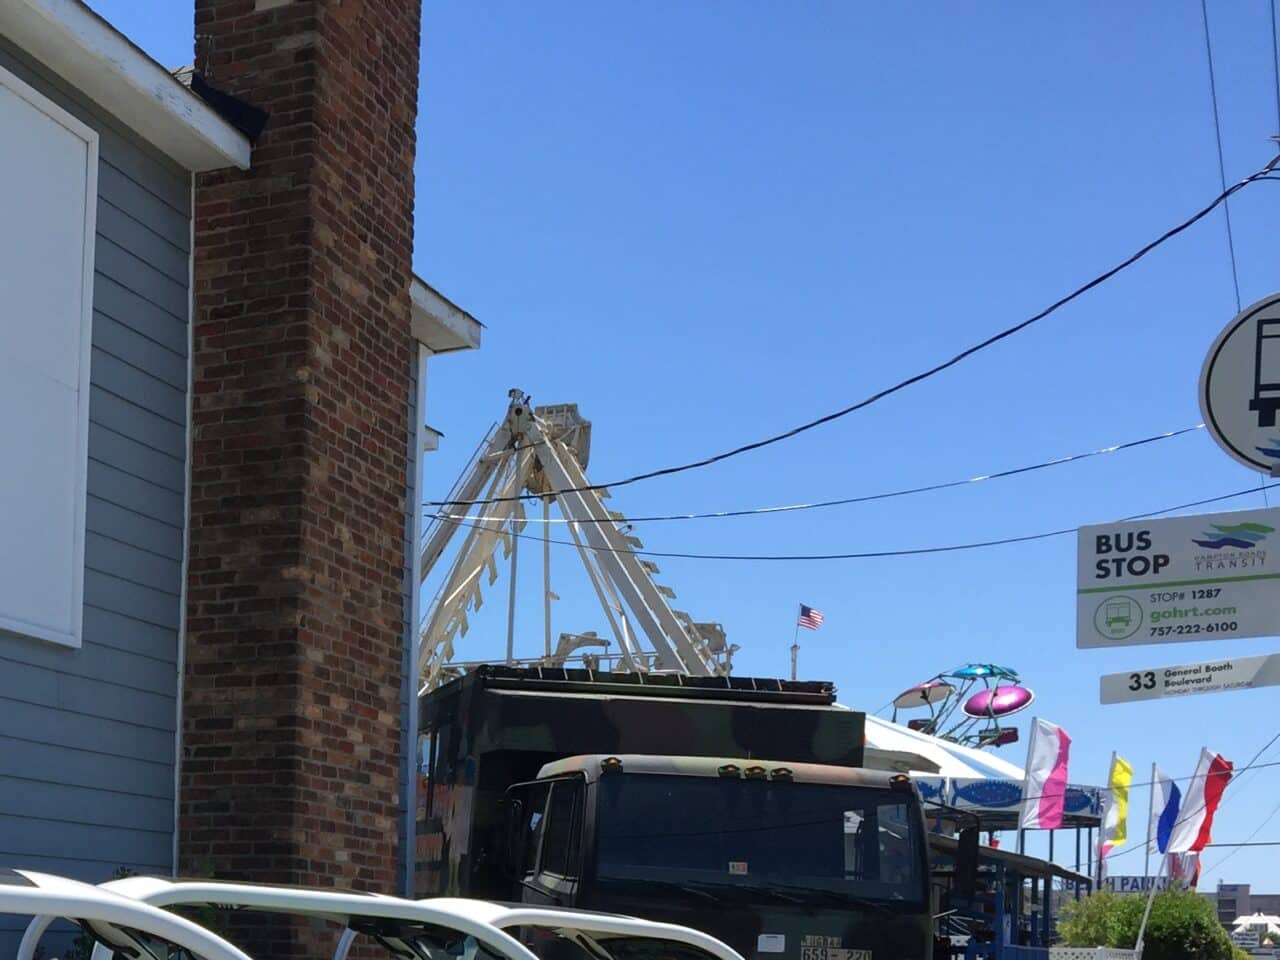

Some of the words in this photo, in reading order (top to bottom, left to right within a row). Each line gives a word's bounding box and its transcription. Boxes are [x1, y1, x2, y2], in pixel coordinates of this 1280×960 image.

[1095, 530, 1152, 555] BUS
[1095, 554, 1170, 580] STOP
[1195, 558, 1266, 571] TRANSIT
[1191, 588, 1222, 600] 1287
[1149, 605, 1237, 624] gohrt.com
[1149, 621, 1238, 637] 757-222-6100
[1128, 671, 1157, 692] 33
[1163, 665, 1202, 678] General
[1205, 662, 1233, 673] Booth
[1163, 675, 1213, 687] Boulevard
